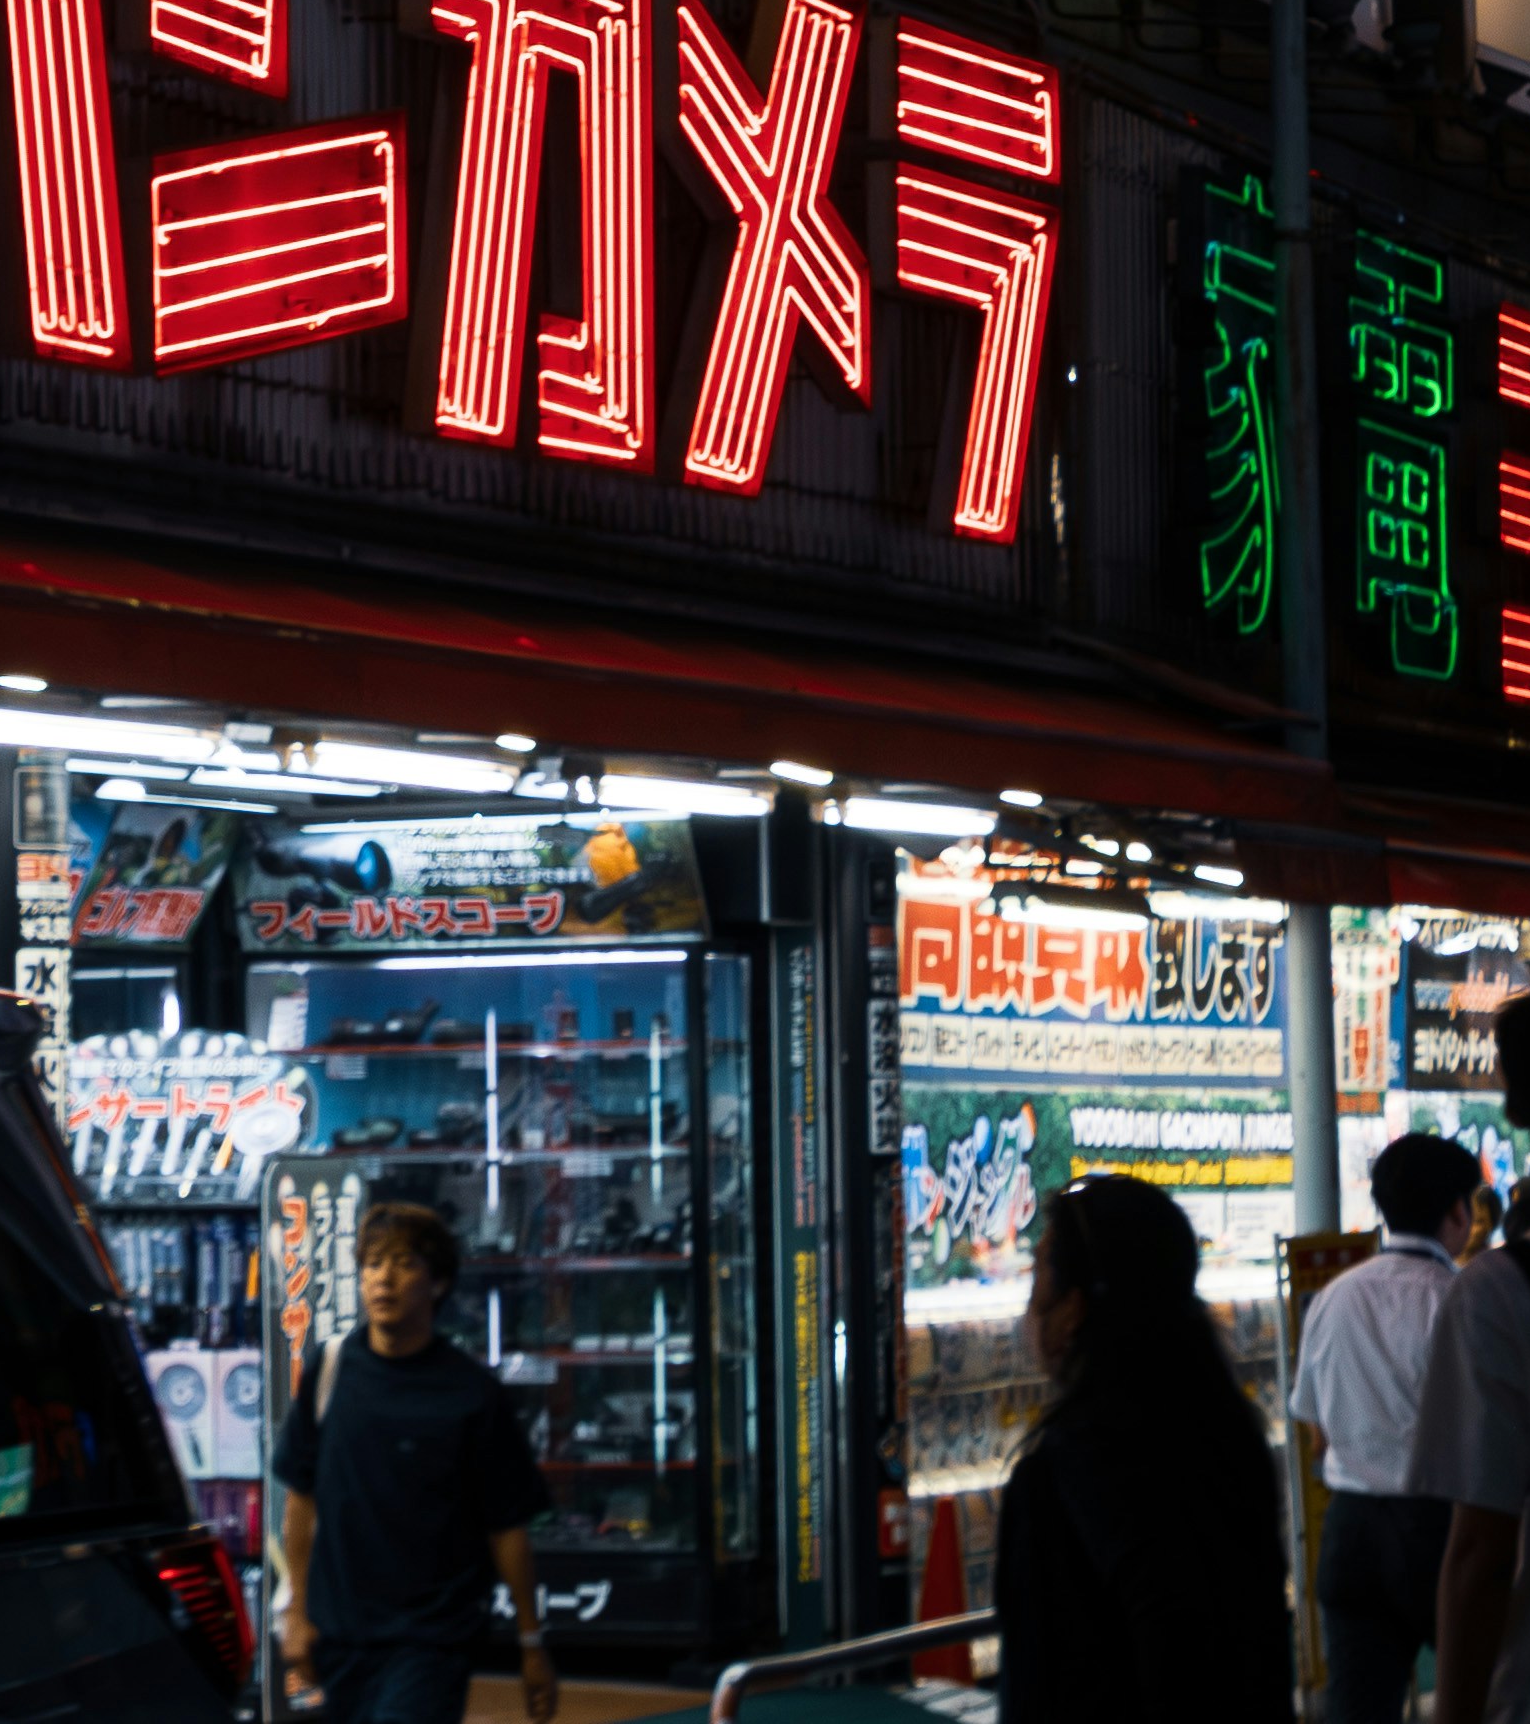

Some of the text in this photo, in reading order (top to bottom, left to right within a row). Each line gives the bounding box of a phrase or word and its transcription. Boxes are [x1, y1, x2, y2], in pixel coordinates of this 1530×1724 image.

[247, 886, 565, 945] フィールドスコープ
